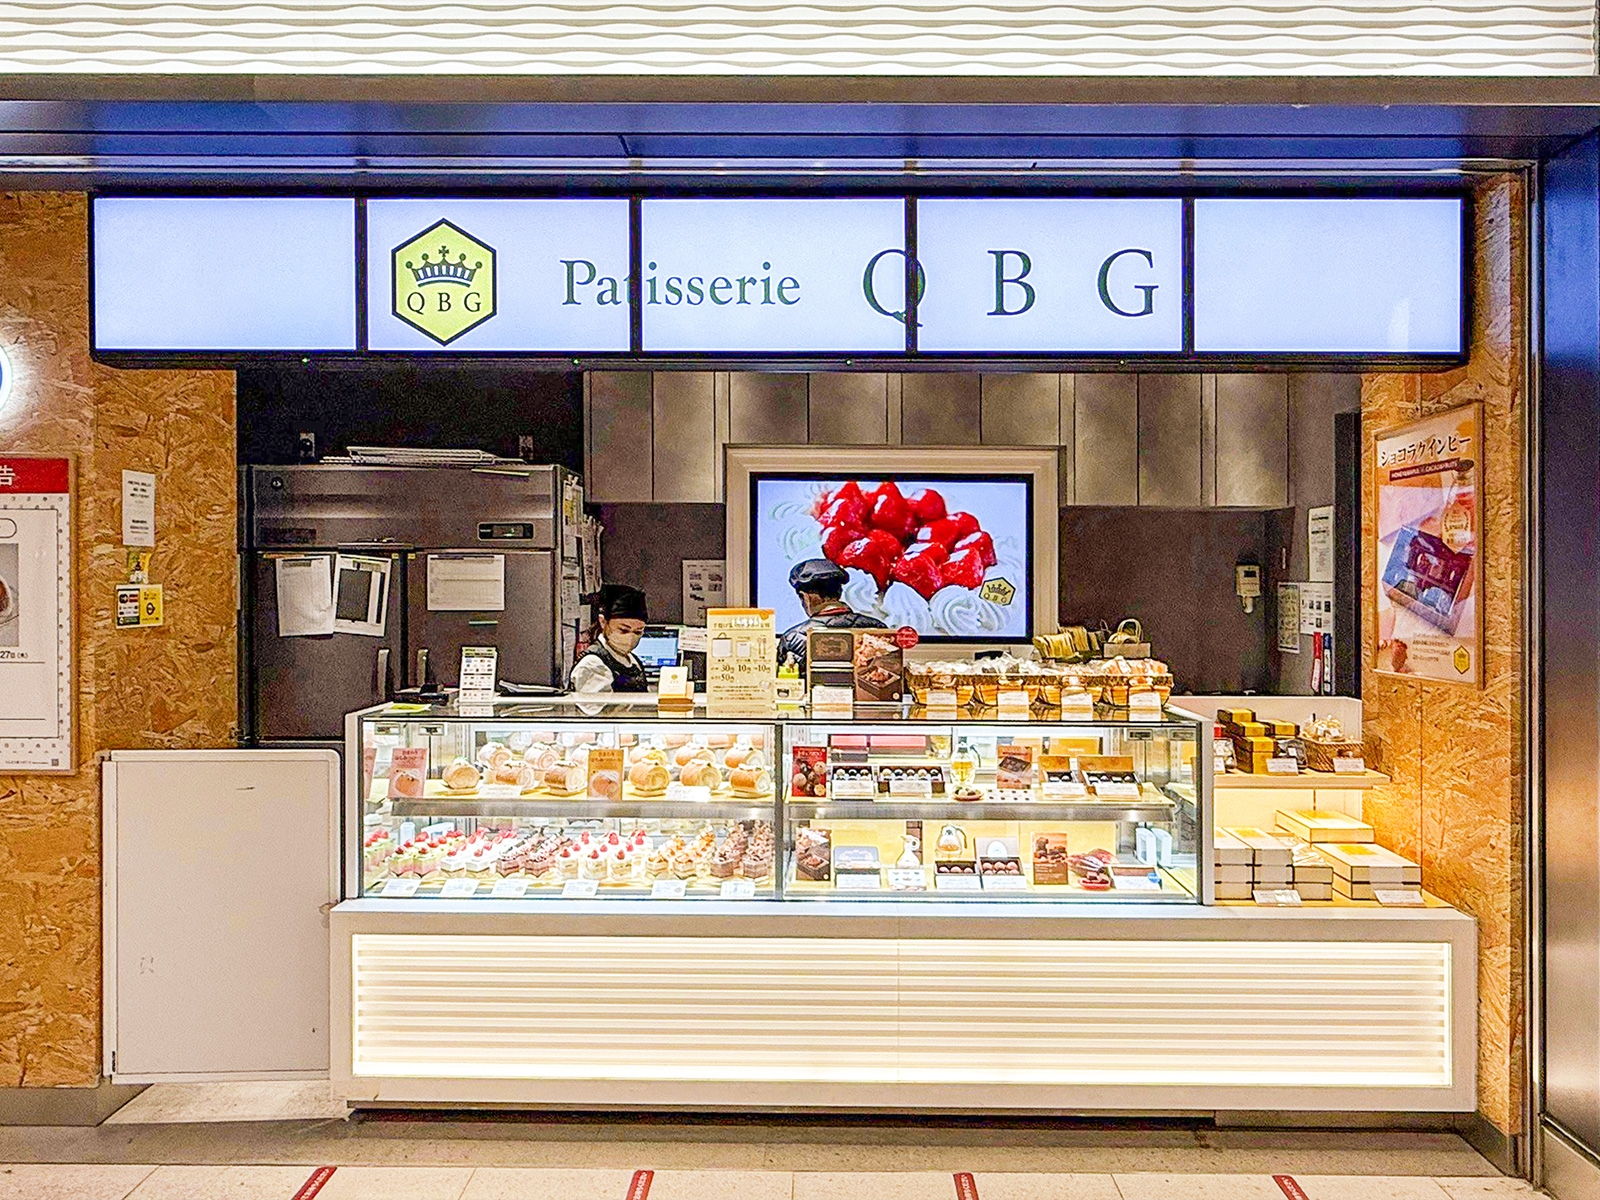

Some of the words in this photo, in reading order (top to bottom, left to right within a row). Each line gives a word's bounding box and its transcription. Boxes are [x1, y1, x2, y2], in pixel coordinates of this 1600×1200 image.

[987, 250, 1036, 316] B
[1097, 248, 1159, 317] G
[1381, 432, 1472, 467] ショコラクインビー
[0, 464, 16, 487] 告
